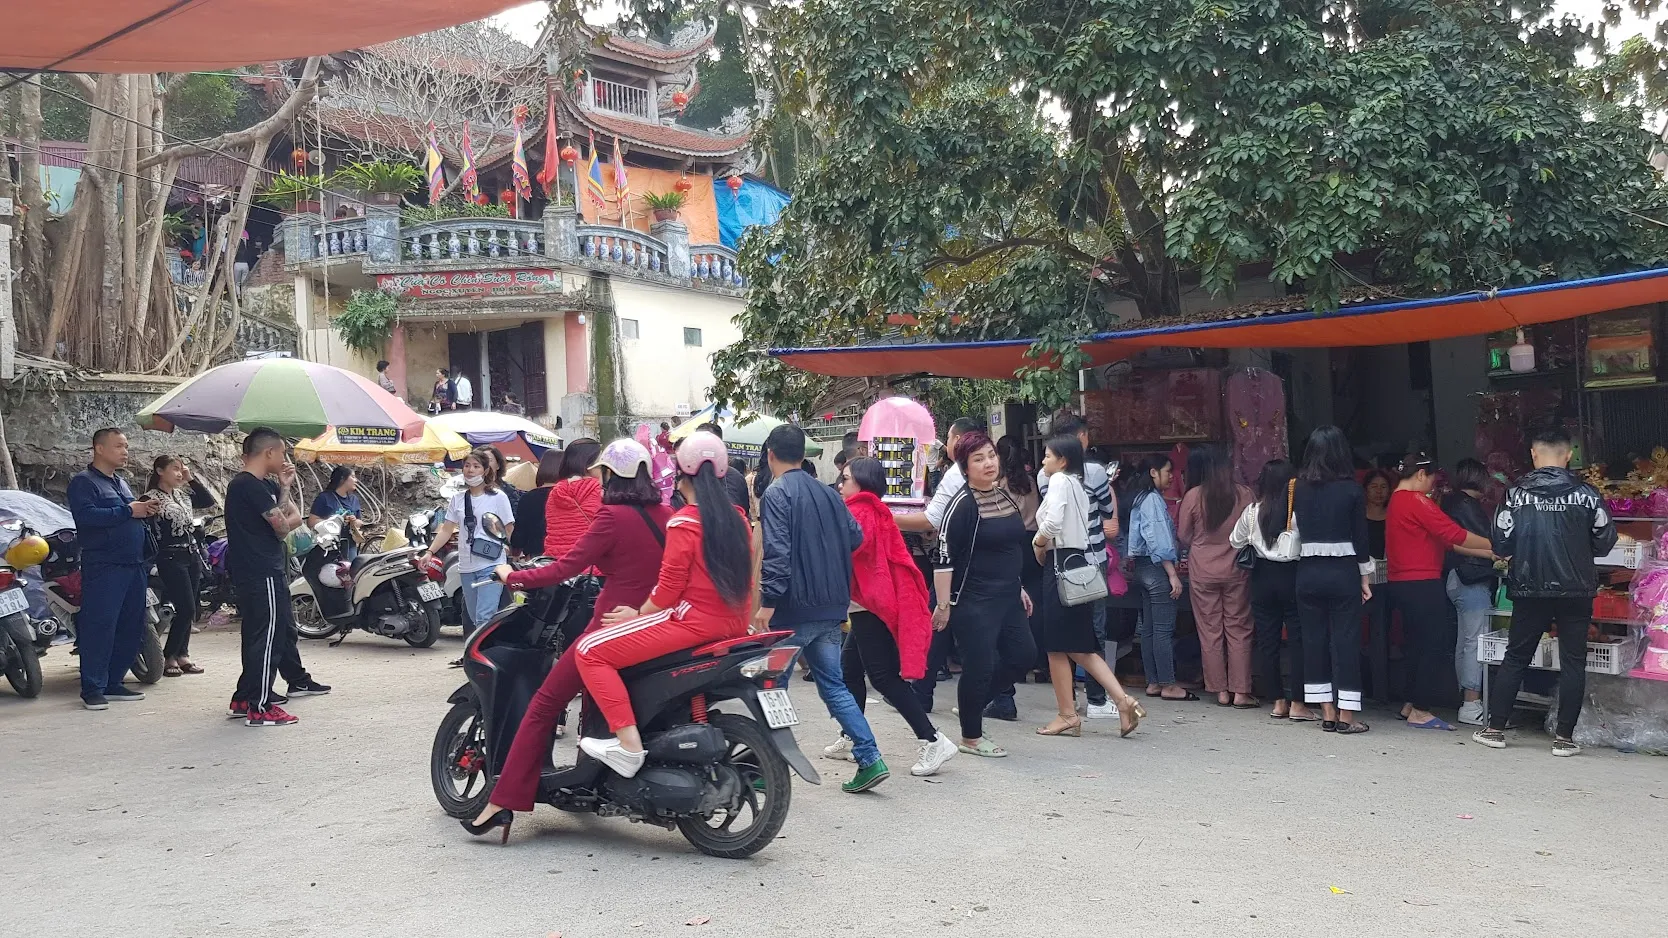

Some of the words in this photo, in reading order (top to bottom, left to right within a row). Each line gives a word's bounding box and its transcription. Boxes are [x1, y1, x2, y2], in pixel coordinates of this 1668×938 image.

[350, 427, 365, 436] KIM
[366, 428, 396, 436] TRANG
[1535, 503, 1566, 512] WORLD
